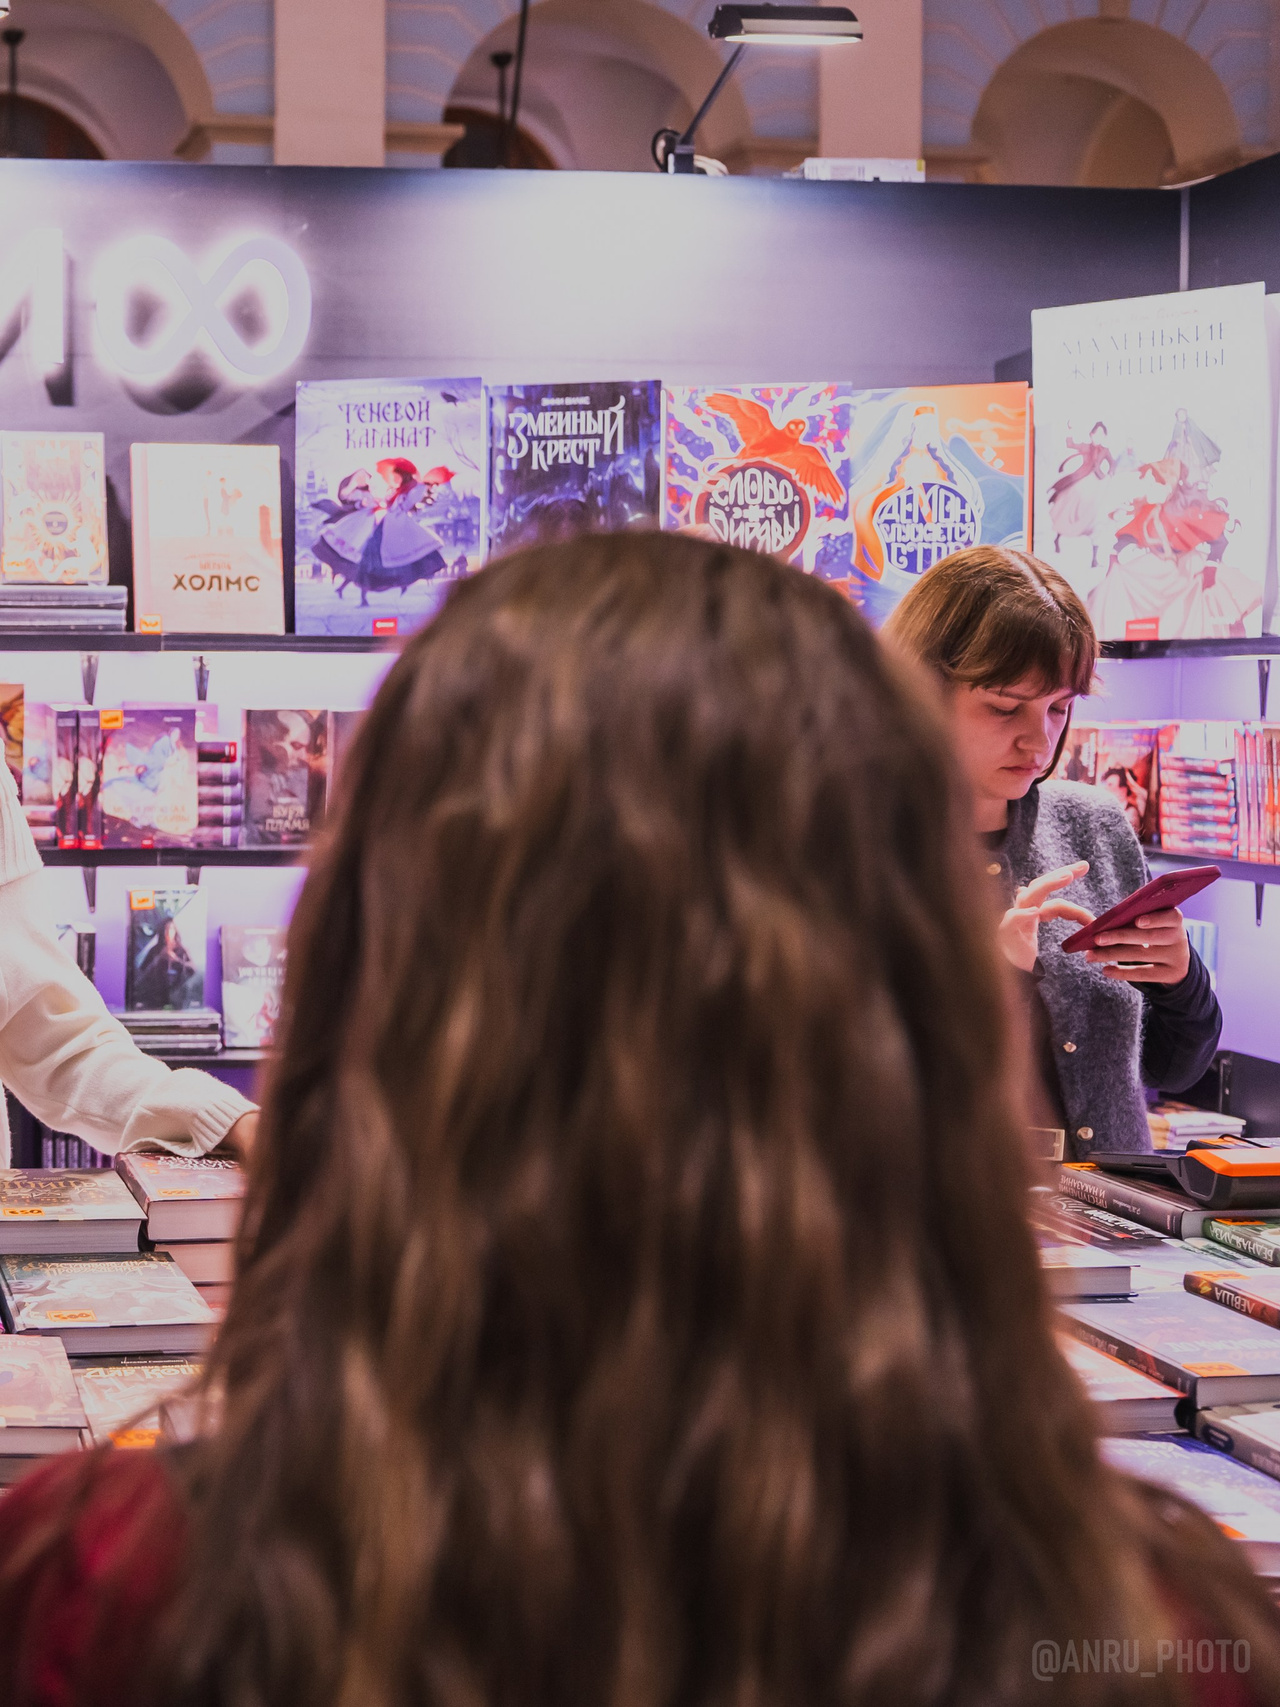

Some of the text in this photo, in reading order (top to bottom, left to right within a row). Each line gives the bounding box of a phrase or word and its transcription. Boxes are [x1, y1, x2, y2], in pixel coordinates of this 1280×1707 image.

[337, 396, 429, 424] ТЕНЕВОЙ
[345, 426, 435, 449] КАГАНАТ
[507, 395, 626, 459] ЗМЕИНЫЙ
[530, 438, 599, 472] КРЕСТ
[710, 468, 793, 506] СЛОВО
[173, 574, 260, 592] ХОЛМС
[1060, 1174, 1099, 1196] НАКАЗАНИЕ
[1209, 1225, 1274, 1262] БЕДНАЯ ЛИЗА
[1215, 1286, 1256, 1314] ЛЕВША
